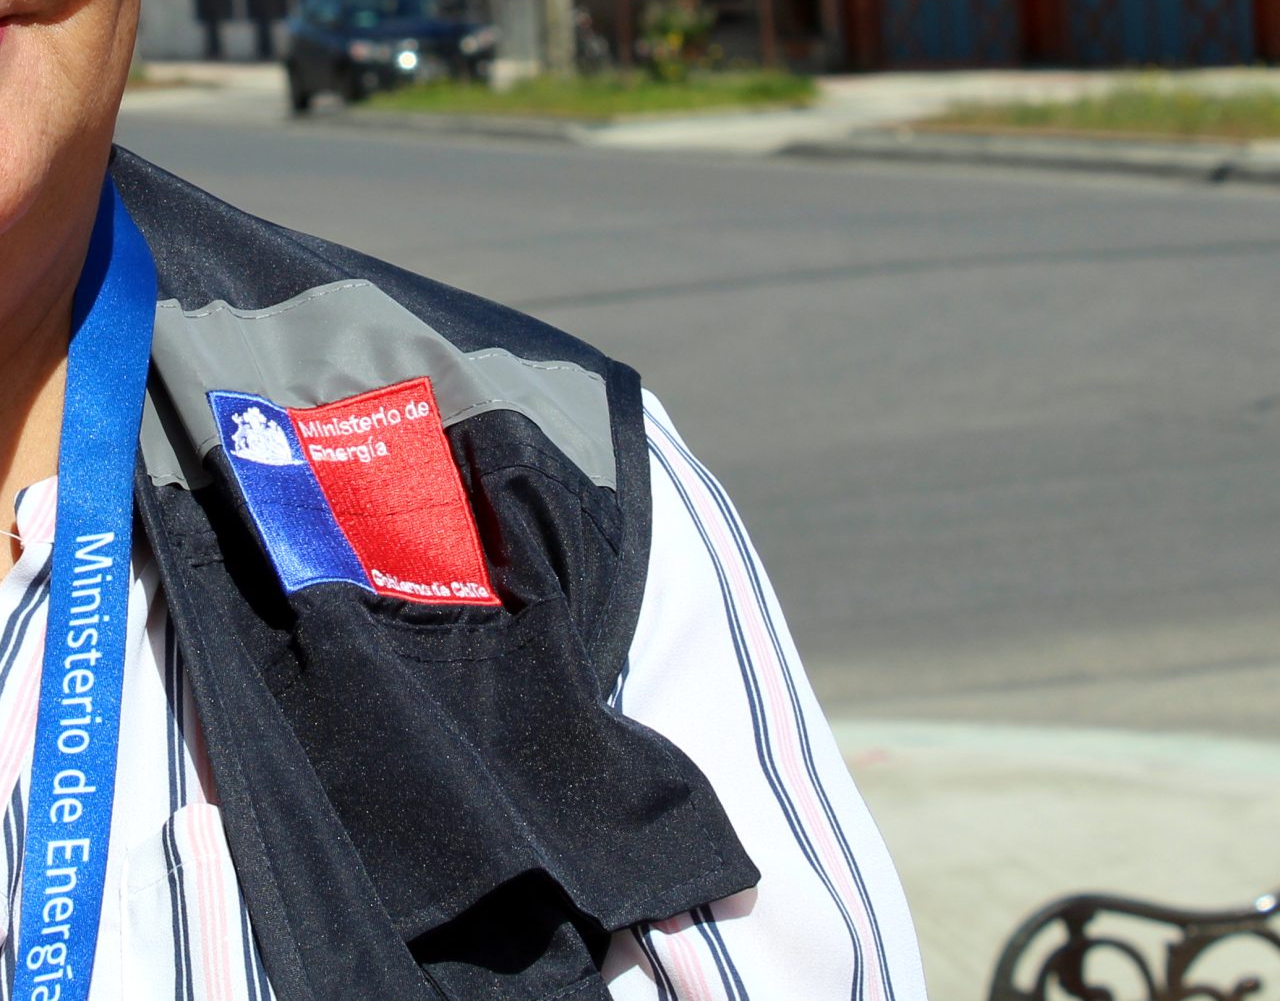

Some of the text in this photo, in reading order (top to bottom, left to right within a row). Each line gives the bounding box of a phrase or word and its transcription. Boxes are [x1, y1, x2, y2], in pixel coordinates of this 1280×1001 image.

[297, 399, 430, 438] Ministerio de
[308, 435, 391, 463] Energía
[57, 531, 115, 755] Ministerio
[48, 769, 97, 824] de
